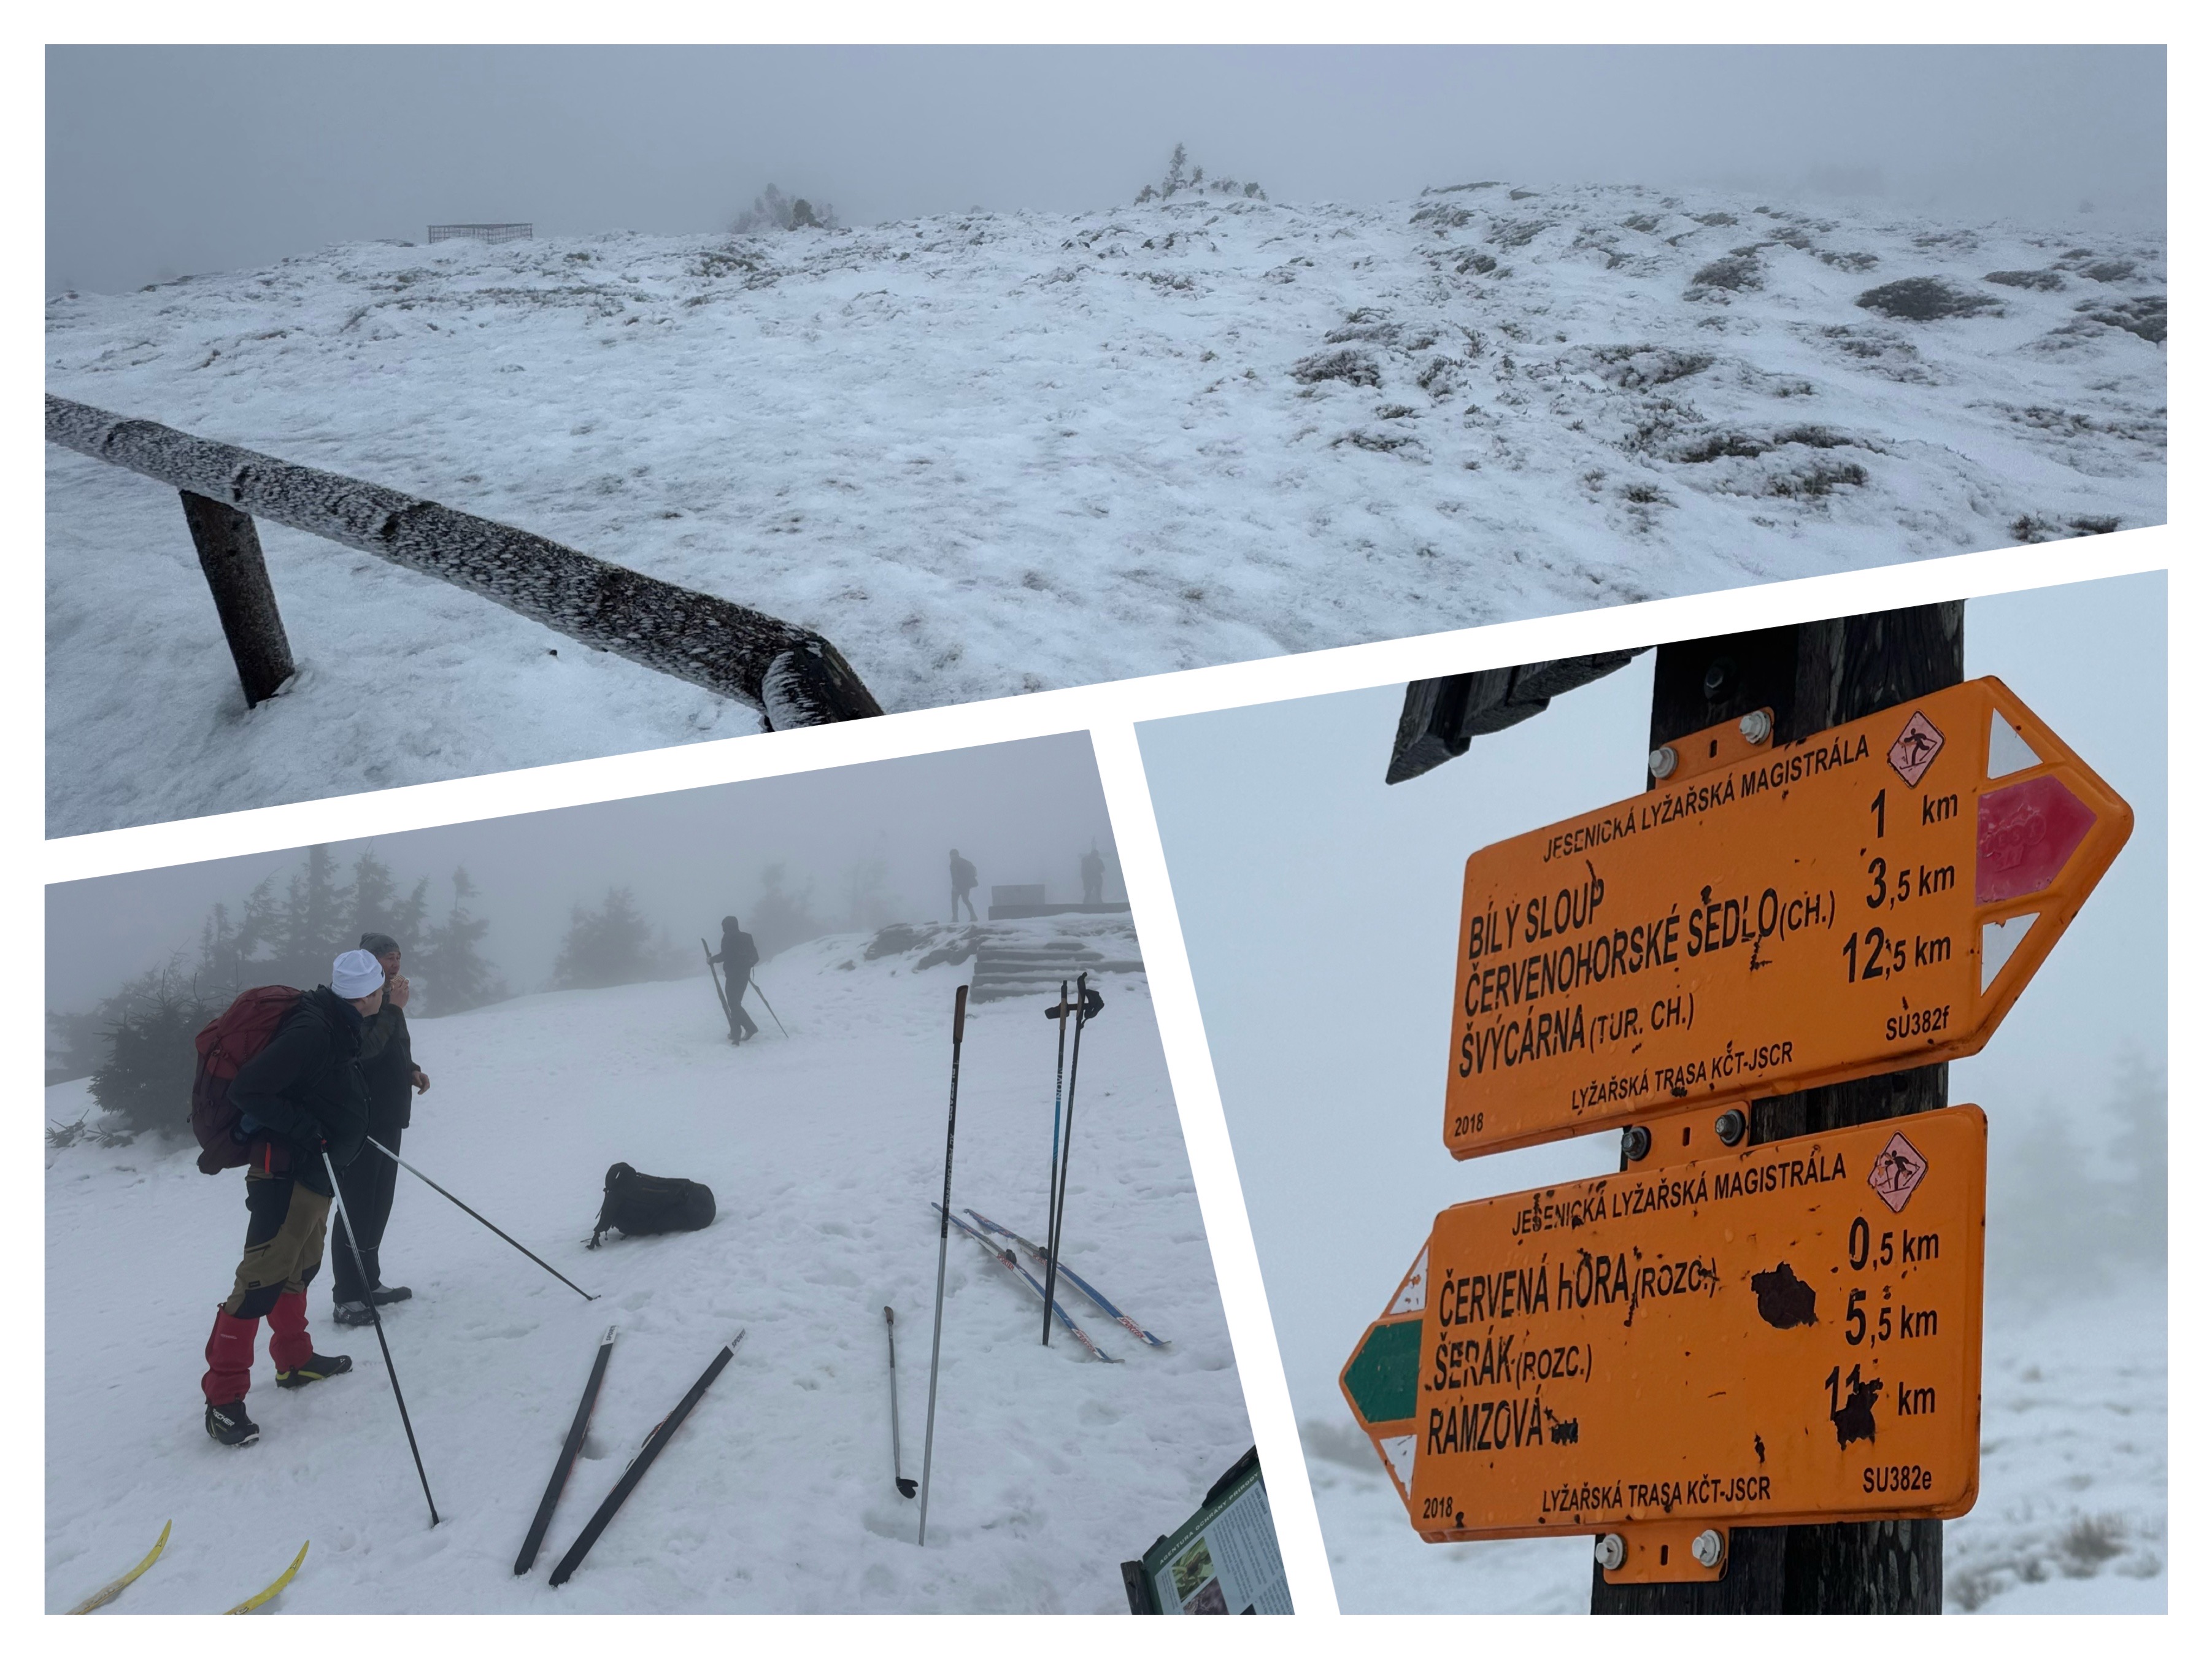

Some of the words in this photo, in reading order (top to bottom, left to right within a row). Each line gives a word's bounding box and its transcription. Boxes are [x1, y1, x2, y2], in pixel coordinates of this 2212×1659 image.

[1543, 806, 1636, 863] JESENICKÁ
[1642, 772, 1735, 831] LYŽAŘSKÁ
[1741, 734, 1870, 798] MAGISTRÁLA
[1871, 788, 1886, 839] 1
[1922, 794, 1958, 826] km
[1525, 878, 1605, 944] SLOUP
[1867, 857, 1911, 911] 3,5
[1919, 864, 1956, 897] km
[1465, 903, 1680, 1018] ČERVENOHORSKÉ
[1843, 927, 1906, 983] 12,5
[1915, 936, 1951, 968] km
[1459, 1004, 1586, 1079] ŠVÝCÁRNA
[1651, 992, 1694, 1032] CH.)
[1886, 1005, 1951, 1041] SU382f
[1571, 1068, 1650, 1112] LYŽAŘSKÁ
[1655, 1062, 1706, 1092] TRASA
[1711, 1041, 1793, 1079] KČT-JSCR
[1454, 1112, 1484, 1138] 2018
[1513, 1190, 1607, 1237] JESENICKÁ
[1612, 1171, 1708, 1218] LYŽAŘSKÁ
[1714, 1152, 1846, 1201] MAGISTRÁLA
[1848, 1216, 1894, 1271] 0,5
[1903, 1230, 1940, 1263] km
[1439, 1253, 1549, 1327] ČERVENÁ
[1845, 1289, 1892, 1349] 5,5
[1900, 1305, 1938, 1339] km
[1433, 1325, 1514, 1391] ŠERÁK
[1427, 1384, 1543, 1455] RAMZOVÁ
[1897, 1381, 1936, 1416] km
[1542, 1480, 1624, 1514] LYŽAŘSKÁ
[1628, 1482, 1682, 1508] TRASA
[1687, 1474, 1771, 1505] KČT-JSCR
[1862, 1465, 1932, 1493] SU382e
[1195, 1501, 1227, 1531] OCHRANY
[1423, 1496, 1454, 1519] 2018
